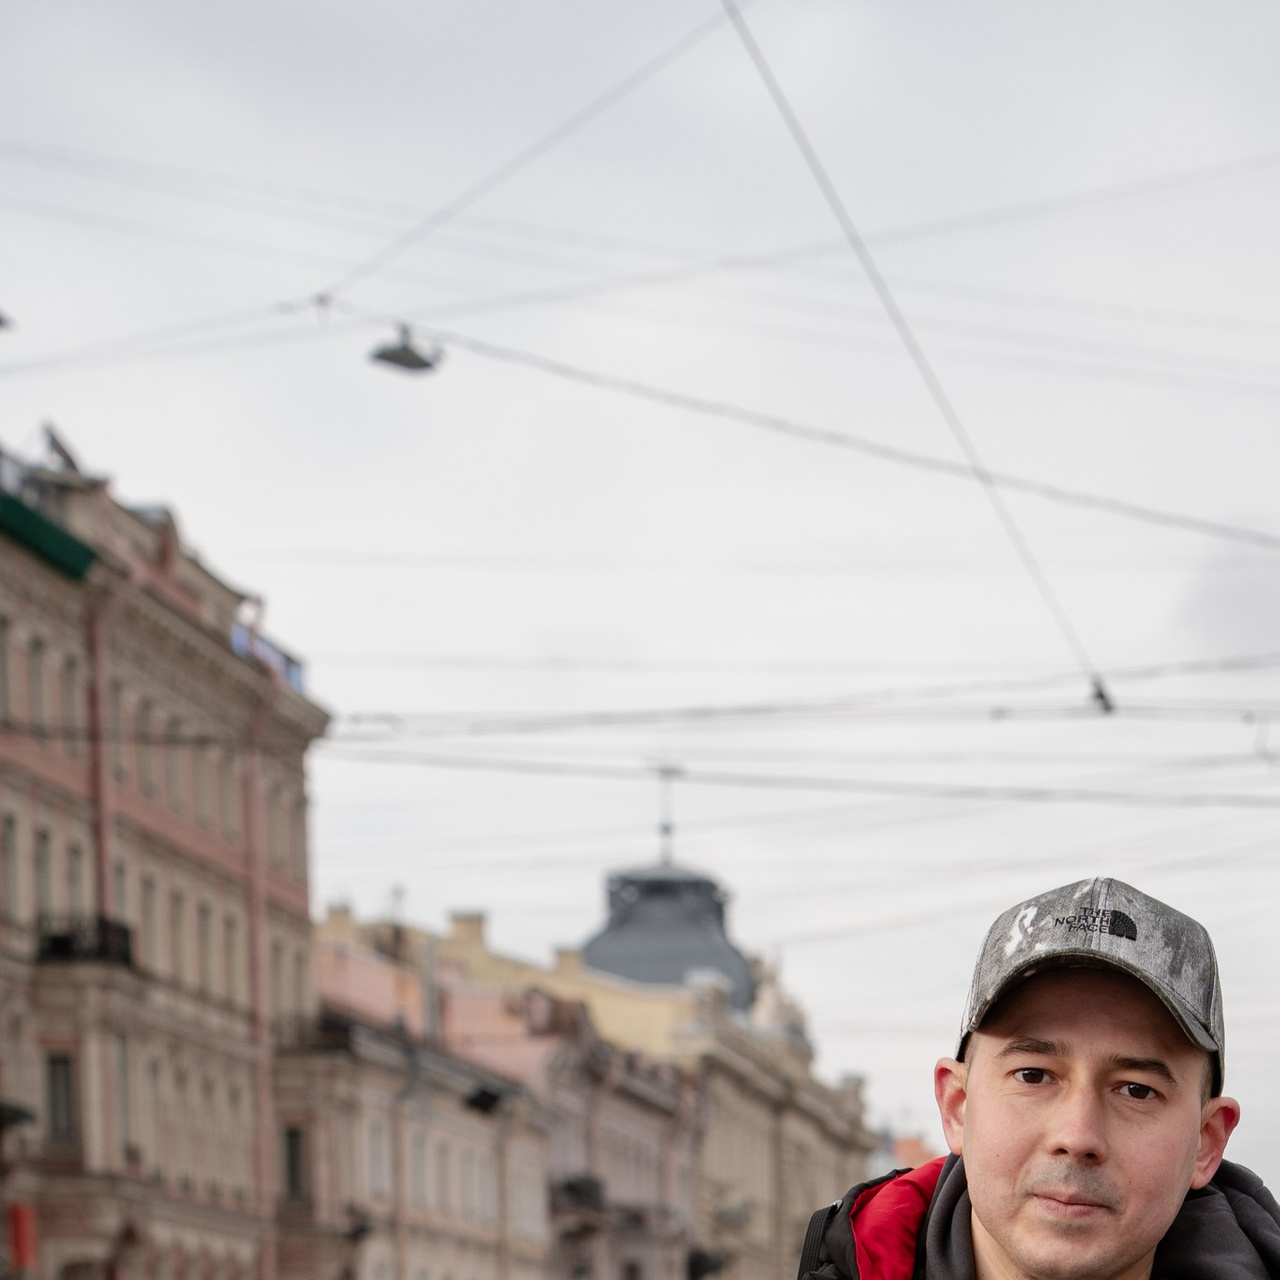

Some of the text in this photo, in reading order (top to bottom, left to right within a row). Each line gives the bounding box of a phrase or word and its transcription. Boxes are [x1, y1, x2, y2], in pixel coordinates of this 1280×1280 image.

[1080, 907, 1111, 918] THE
[1054, 914, 1110, 927] NORTH
[1068, 923, 1108, 934] FACE
